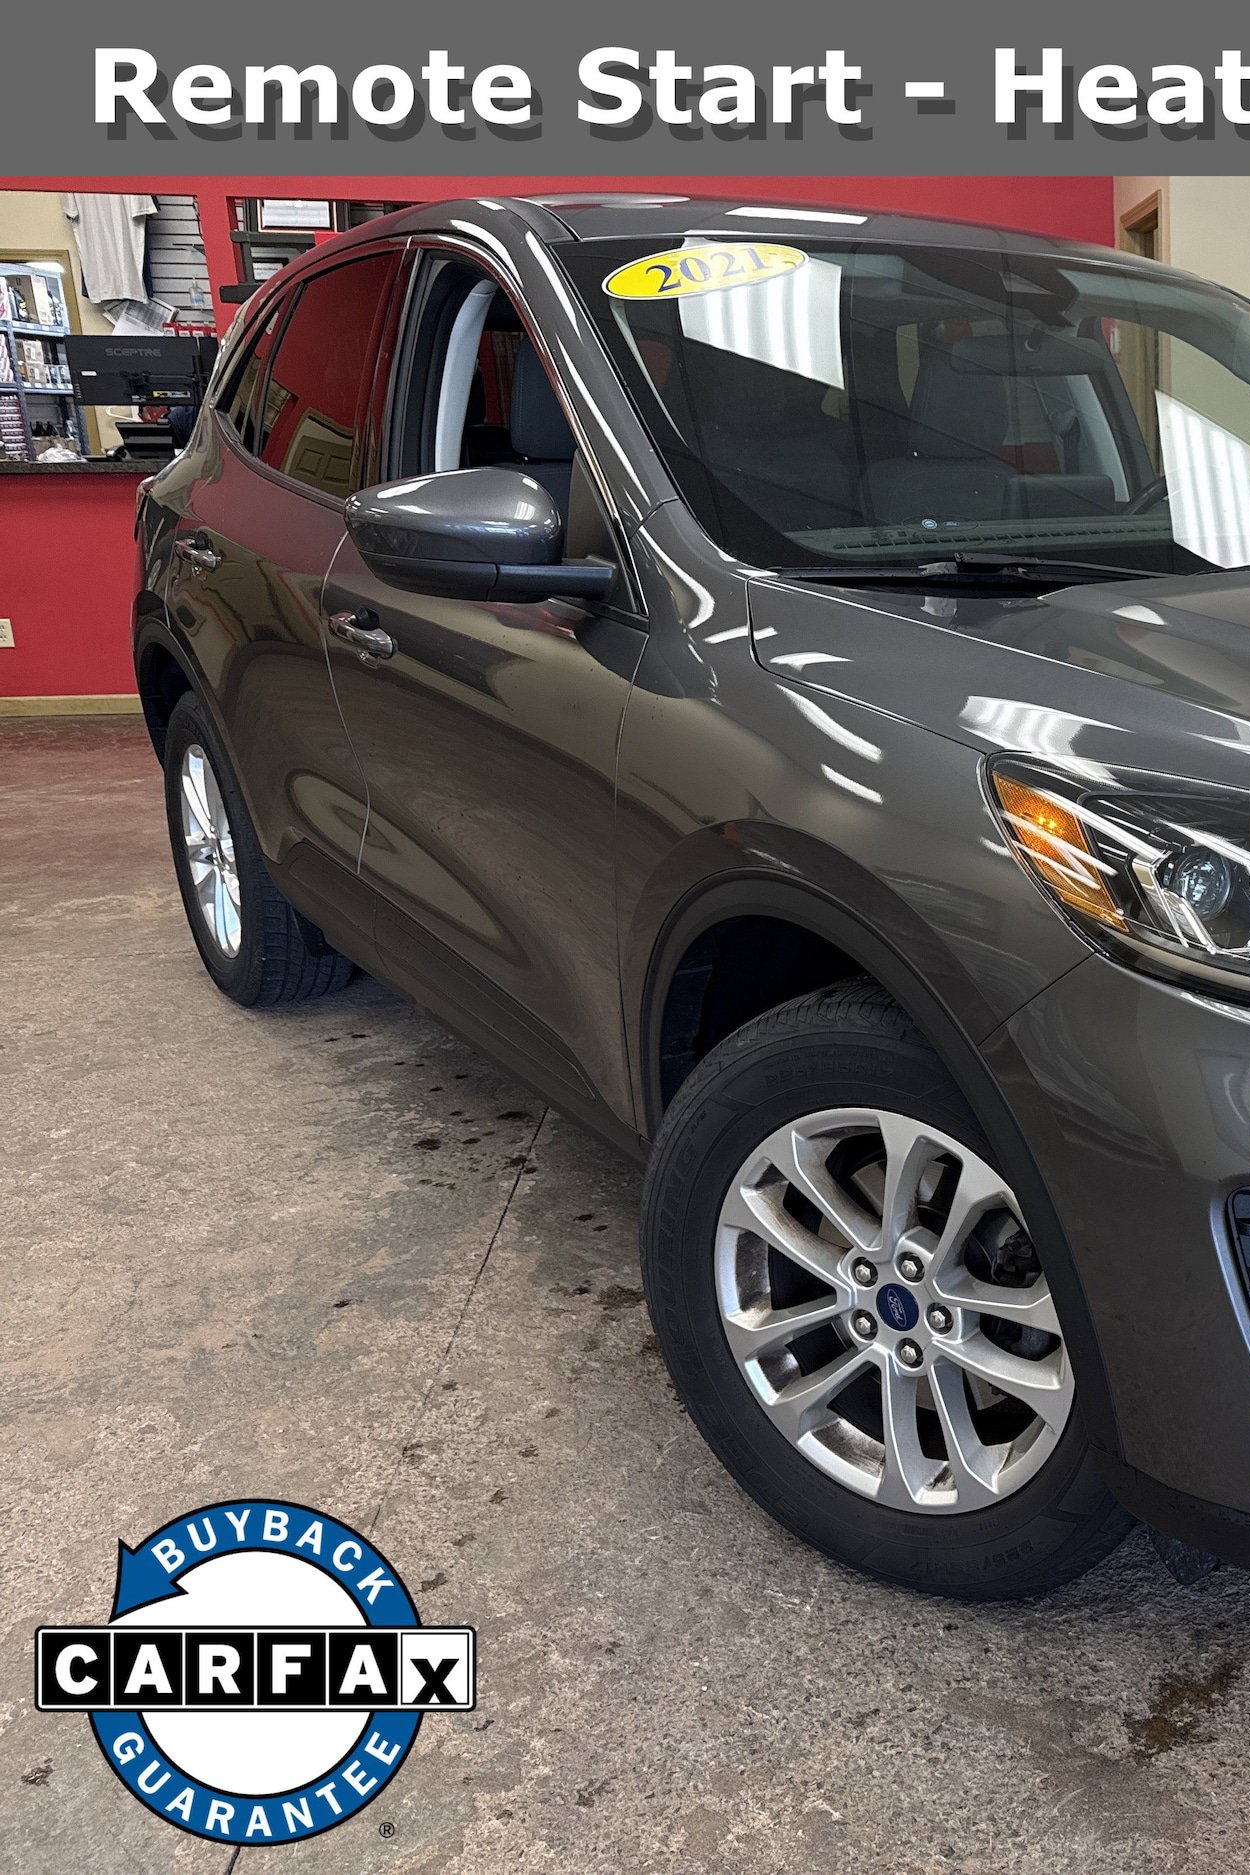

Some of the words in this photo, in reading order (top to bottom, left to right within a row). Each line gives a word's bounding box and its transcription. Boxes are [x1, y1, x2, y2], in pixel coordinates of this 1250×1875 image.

[645, 246, 772, 293] 2021
[105, 347, 161, 357] SCEPTRE
[888, 1296, 904, 1321] Ford
